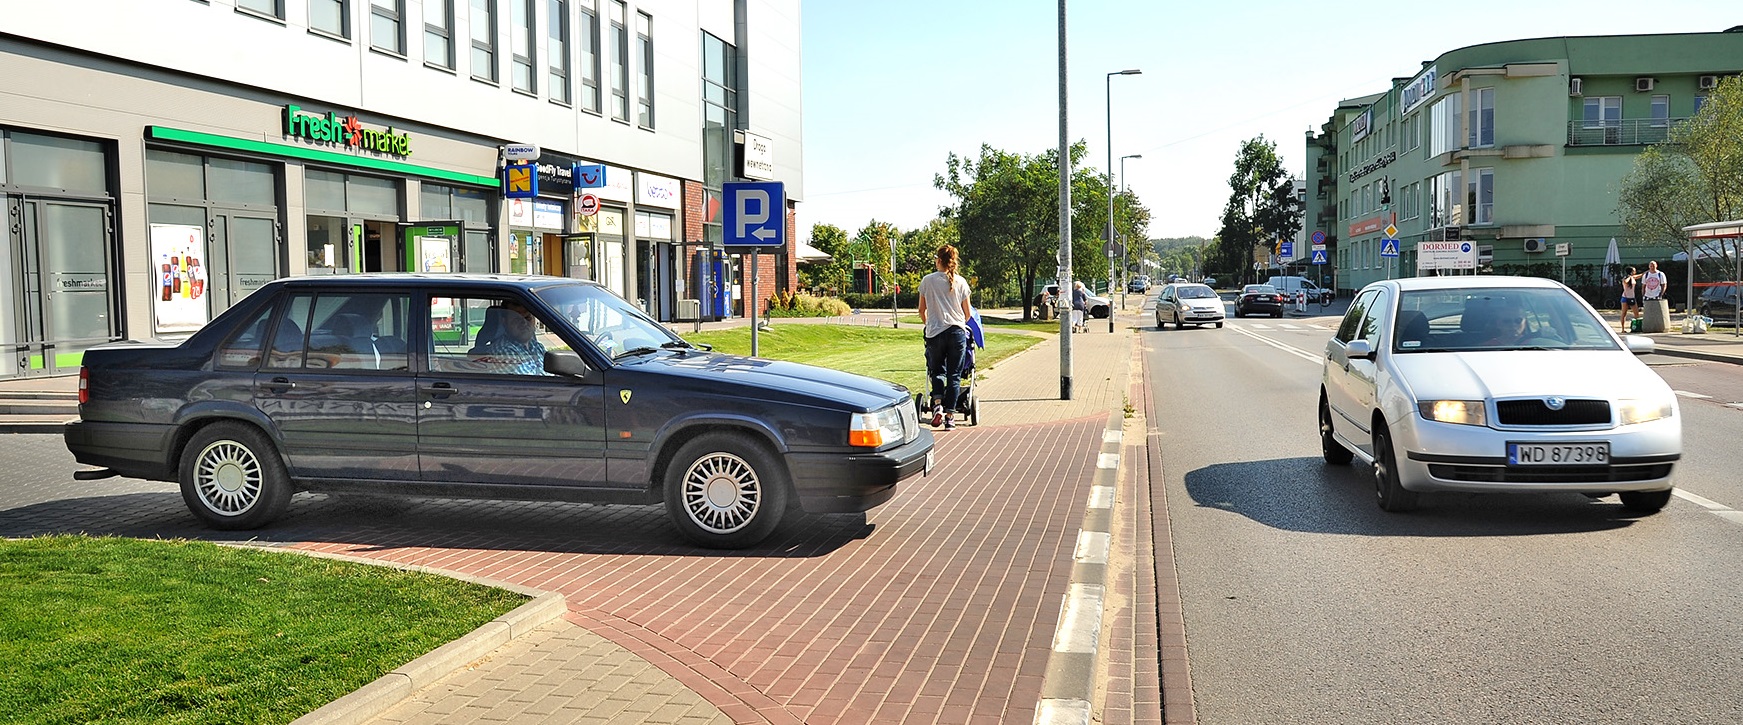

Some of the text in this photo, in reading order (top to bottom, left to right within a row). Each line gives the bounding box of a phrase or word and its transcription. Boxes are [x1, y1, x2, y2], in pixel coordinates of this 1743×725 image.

[288, 104, 413, 157] Fresh market
[556, 165, 571, 178] Travel
[736, 189, 769, 238] P
[1521, 446, 1606, 462] WD 87398
